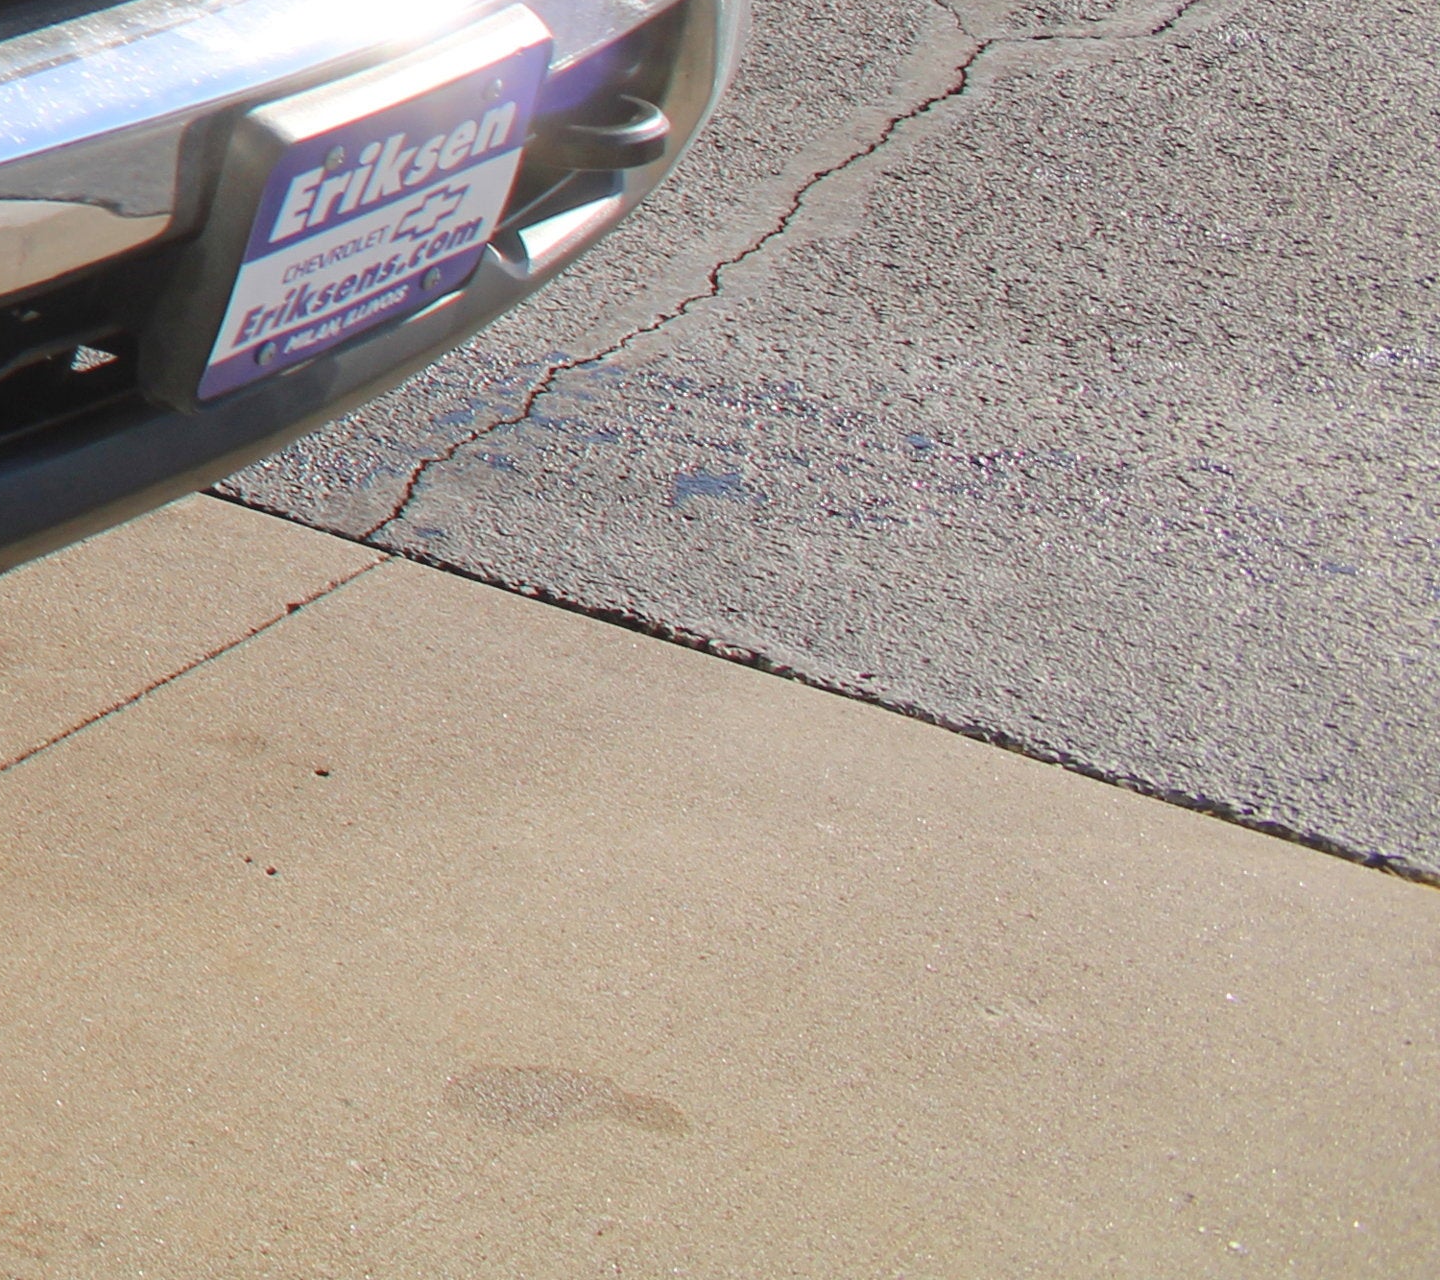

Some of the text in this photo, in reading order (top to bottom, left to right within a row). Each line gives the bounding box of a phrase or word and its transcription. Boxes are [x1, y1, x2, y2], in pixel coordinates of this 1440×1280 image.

[268, 101, 518, 244] Eriksen
[232, 216, 483, 347] Eriksens.com
[281, 224, 391, 286] CHEVROLET
[342, 283, 409, 338] ILLINOIS
